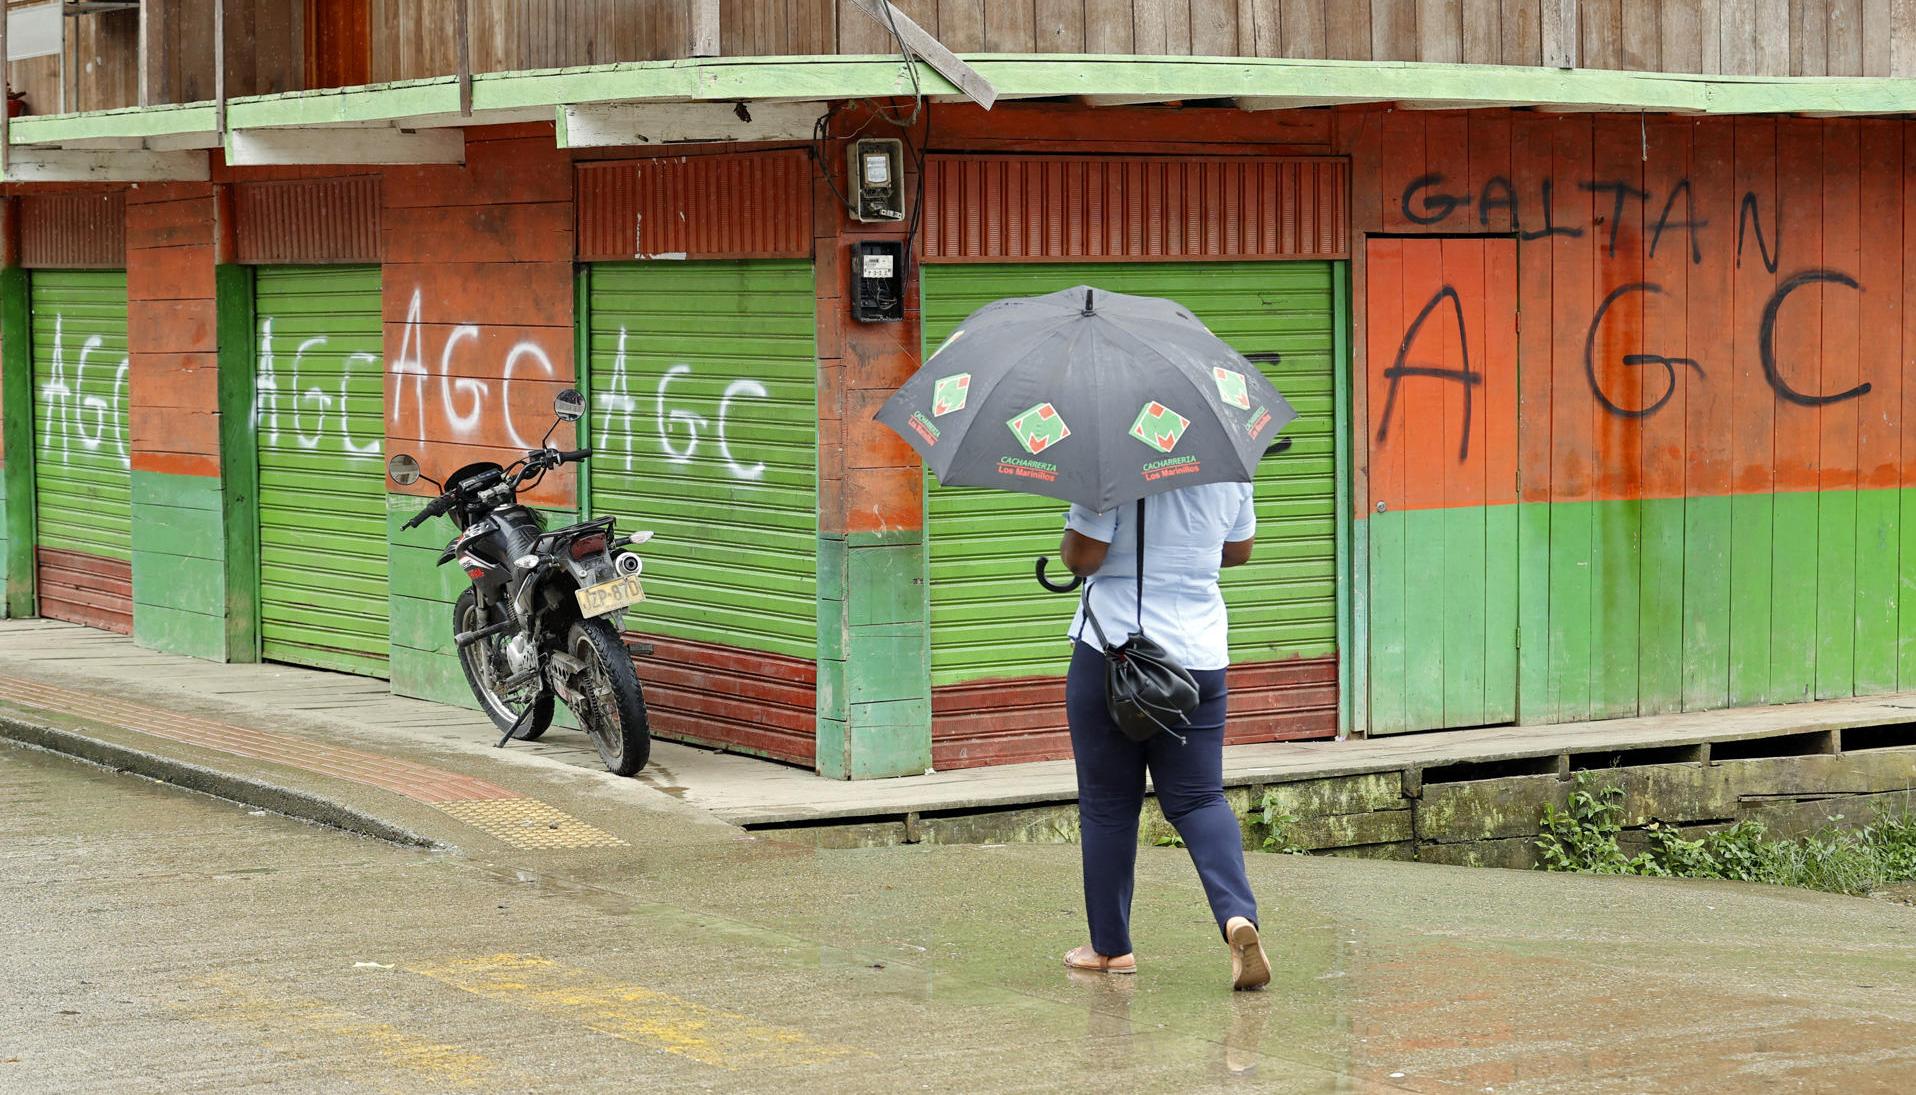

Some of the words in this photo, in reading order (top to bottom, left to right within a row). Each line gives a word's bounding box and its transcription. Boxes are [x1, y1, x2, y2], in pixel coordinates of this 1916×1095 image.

[250, 316, 381, 454] AGC
[391, 286, 556, 452] AGC
[600, 325, 768, 480] AGC
[1374, 266, 1872, 463] AGC
[998, 465, 1013, 475] Los
[1000, 456, 1057, 472] CACHARRERIA
[1143, 455, 1197, 471] CACHARRERIA
